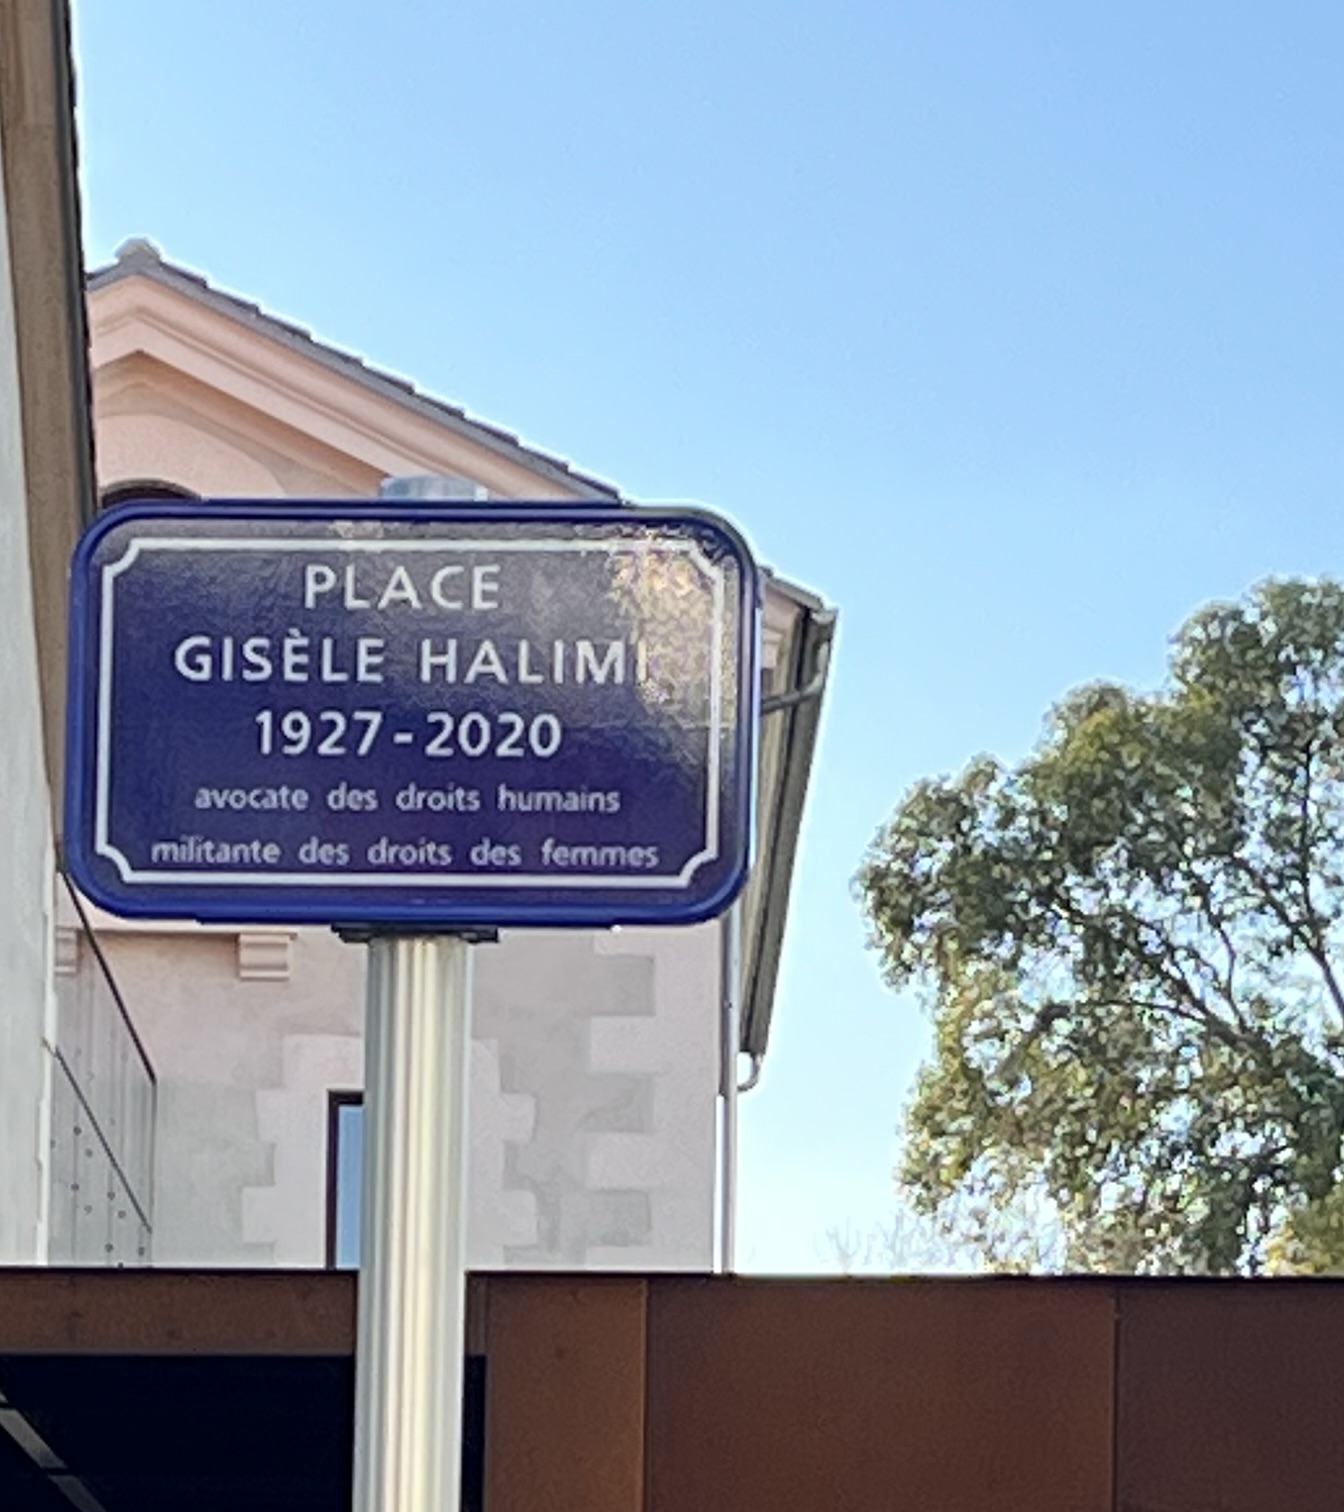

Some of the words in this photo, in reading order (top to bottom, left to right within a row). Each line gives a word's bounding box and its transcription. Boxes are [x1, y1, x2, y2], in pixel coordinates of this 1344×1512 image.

[304, 564, 500, 610] PLACE
[174, 628, 385, 683] GISÈLE
[420, 638, 647, 684] HALIMI
[255, 710, 561, 757] 1927-2020
[194, 784, 309, 811] avocate
[326, 781, 379, 812] des
[395, 782, 481, 812] droits
[497, 783, 621, 813] humains
[151, 834, 281, 864] militante
[298, 836, 350, 865] des
[367, 836, 452, 866] droits
[470, 837, 522, 867] des
[541, 838, 659, 868] femmes
